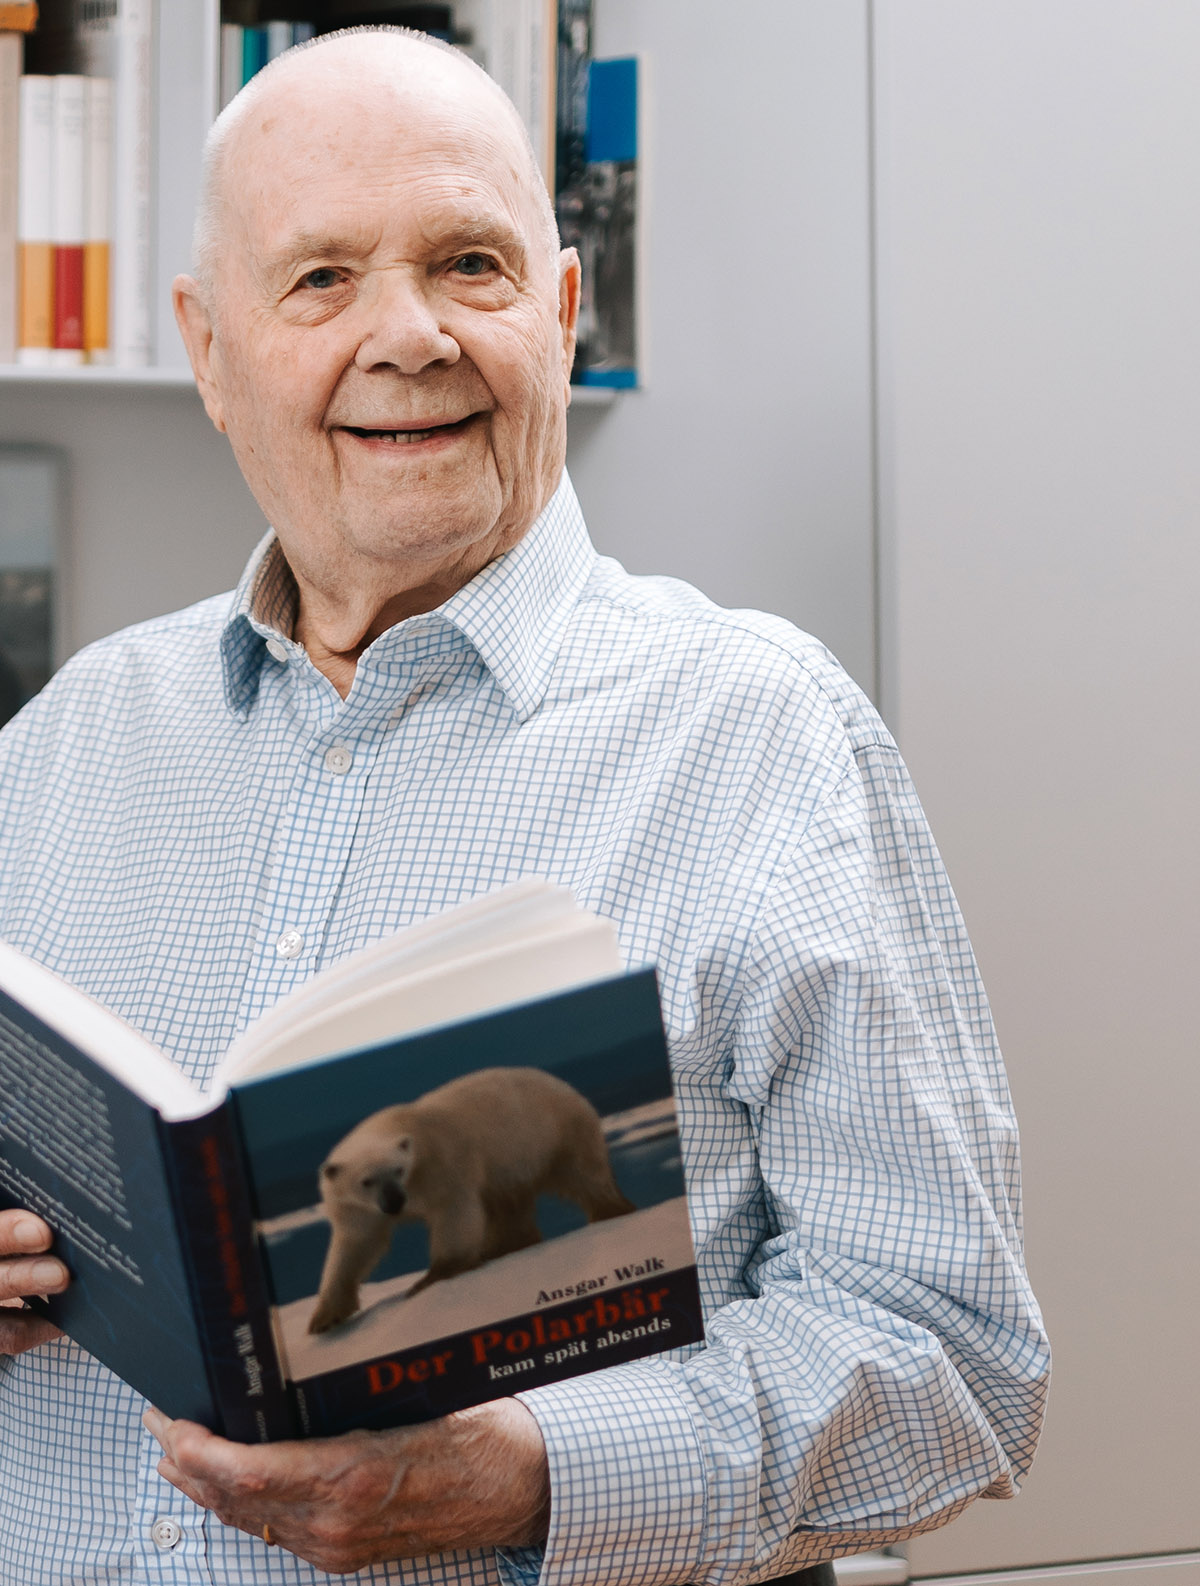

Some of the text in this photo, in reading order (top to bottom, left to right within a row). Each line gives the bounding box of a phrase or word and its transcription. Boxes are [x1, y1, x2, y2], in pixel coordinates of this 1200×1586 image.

[535, 1256, 665, 1305] Ansgar Walk
[364, 1287, 670, 1395] Der Polarbär
[488, 1317, 672, 1380] kam spät abends
[245, 1355, 264, 1397] Ansgar
